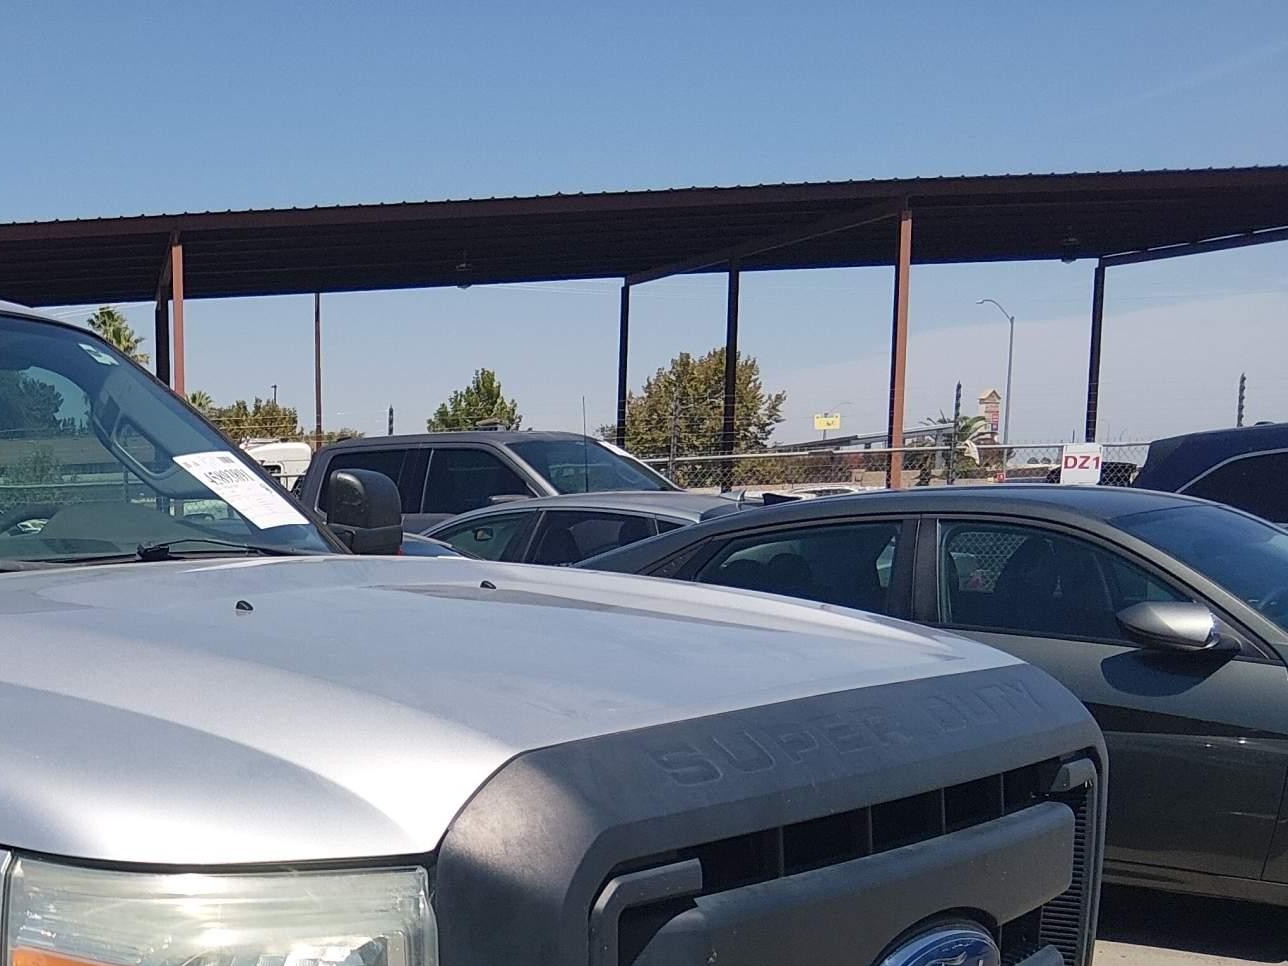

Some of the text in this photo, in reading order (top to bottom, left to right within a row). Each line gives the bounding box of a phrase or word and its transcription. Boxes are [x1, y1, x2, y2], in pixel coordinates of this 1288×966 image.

[1064, 455, 1100, 470] DZ1
[651, 679, 1045, 787] SUPER DUTY
